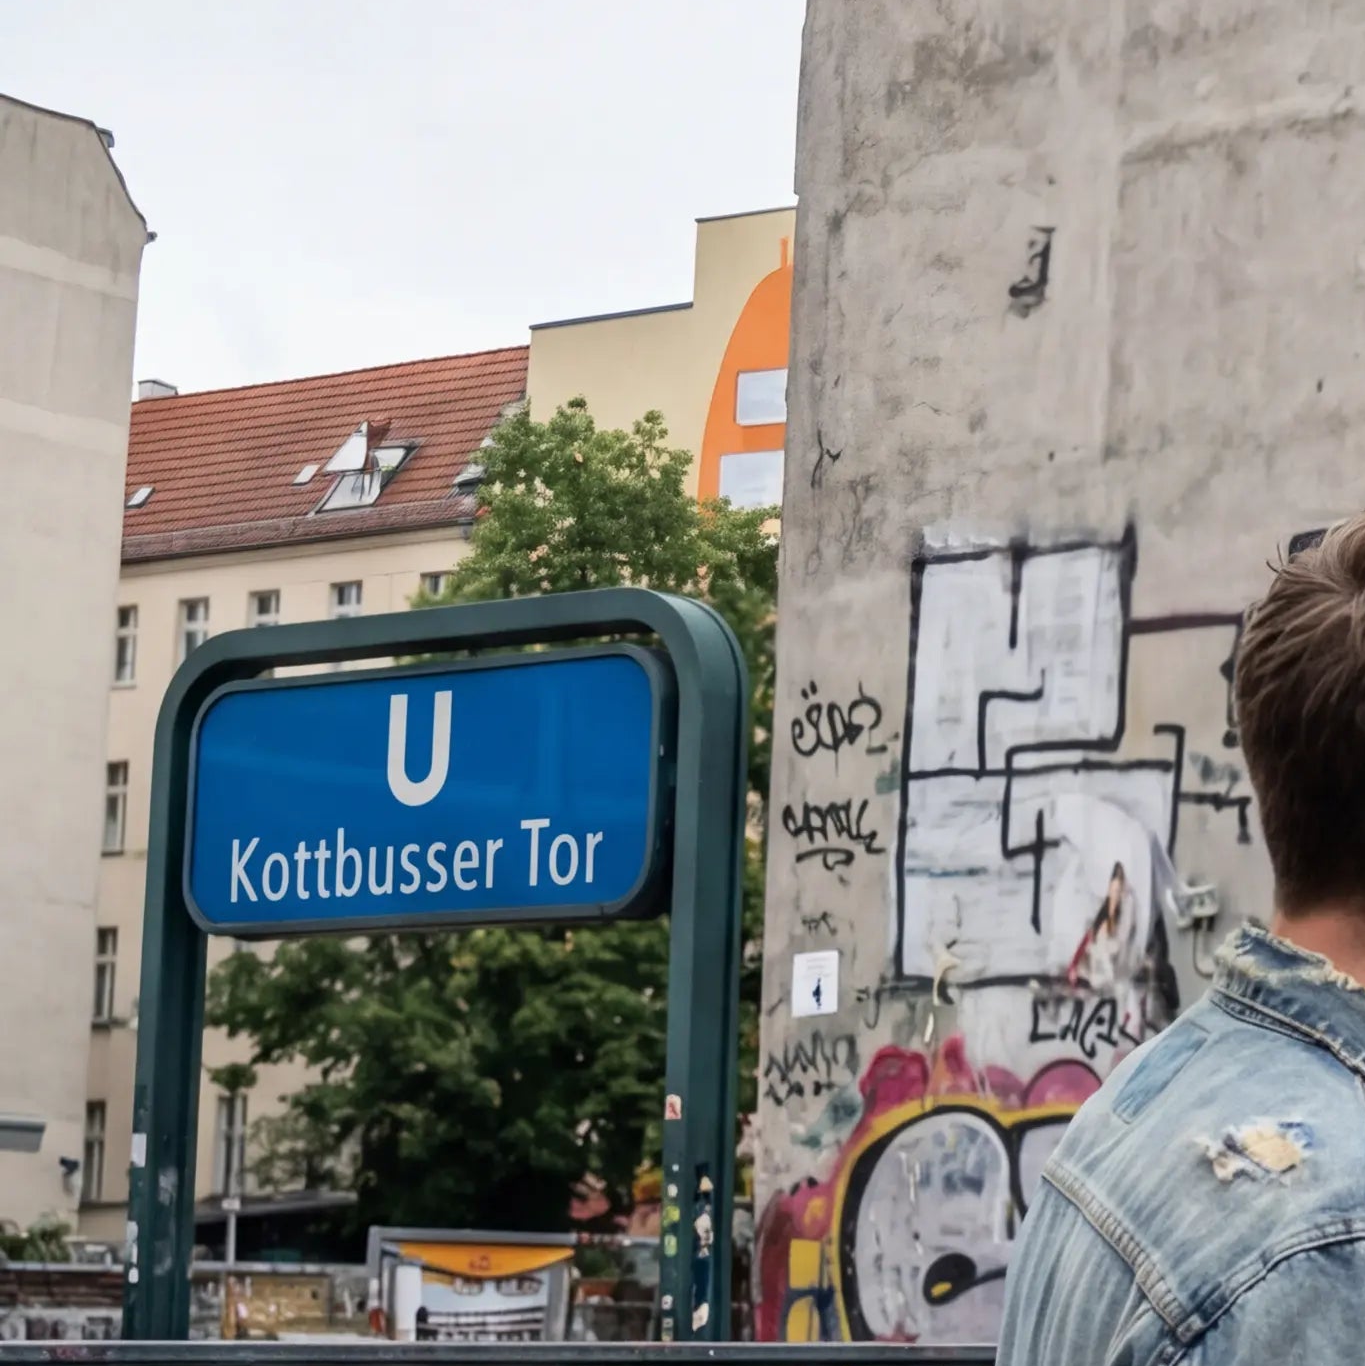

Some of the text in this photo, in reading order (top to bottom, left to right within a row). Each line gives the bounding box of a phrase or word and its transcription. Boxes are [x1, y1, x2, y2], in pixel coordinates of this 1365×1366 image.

[386, 690, 453, 807] U
[229, 818, 604, 903] Kottbusser Tor
